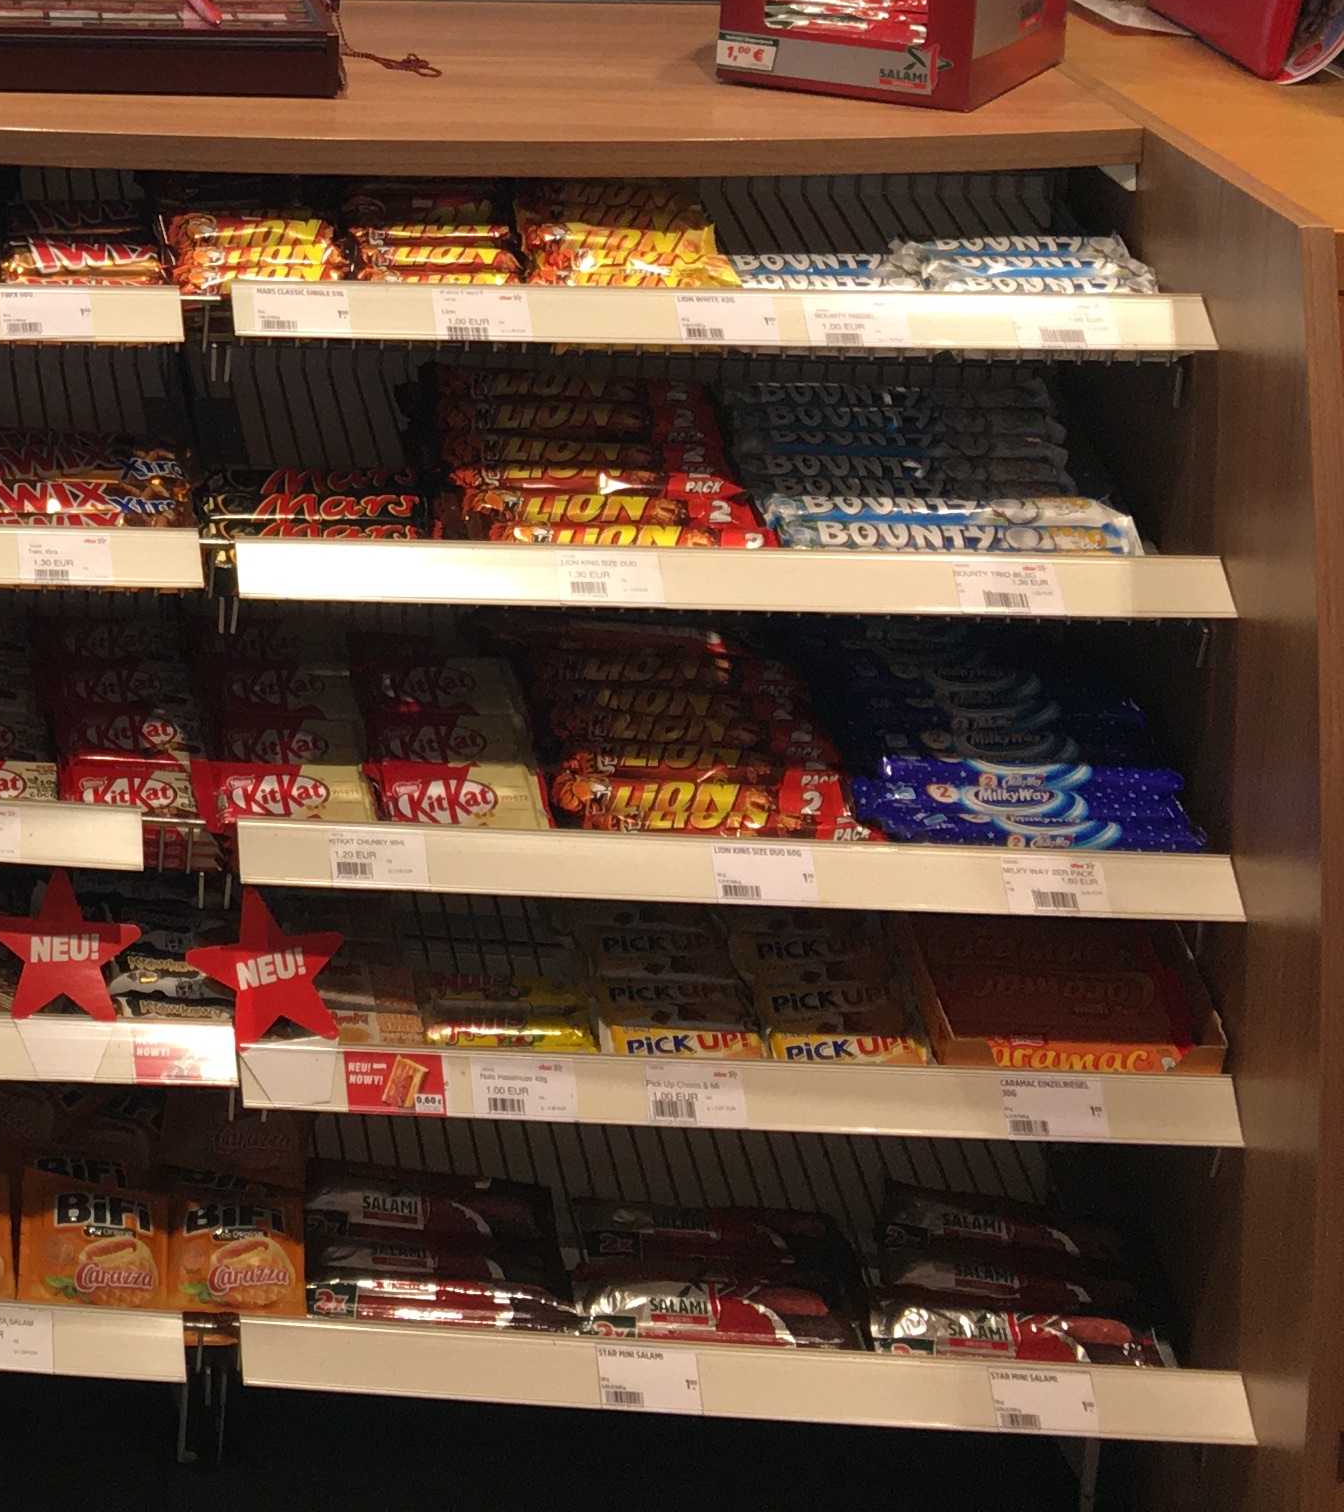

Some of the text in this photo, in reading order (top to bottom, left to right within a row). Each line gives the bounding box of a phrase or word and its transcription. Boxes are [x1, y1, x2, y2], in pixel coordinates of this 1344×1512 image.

[879, 68, 928, 84] SALAMI
[819, 522, 1002, 547] BOUNTY
[244, 775, 329, 808] KitKat
[409, 781, 497, 816] KitKat
[977, 788, 1051, 803] MilkyWay
[30, 934, 100, 962] NEU!
[235, 948, 305, 990] NEU!
[696, 1032, 750, 1053] UP!
[350, 1074, 384, 1086] NOWY!
[362, 1196, 419, 1215] SALAMI
[74, 1259, 154, 1291] Carazza
